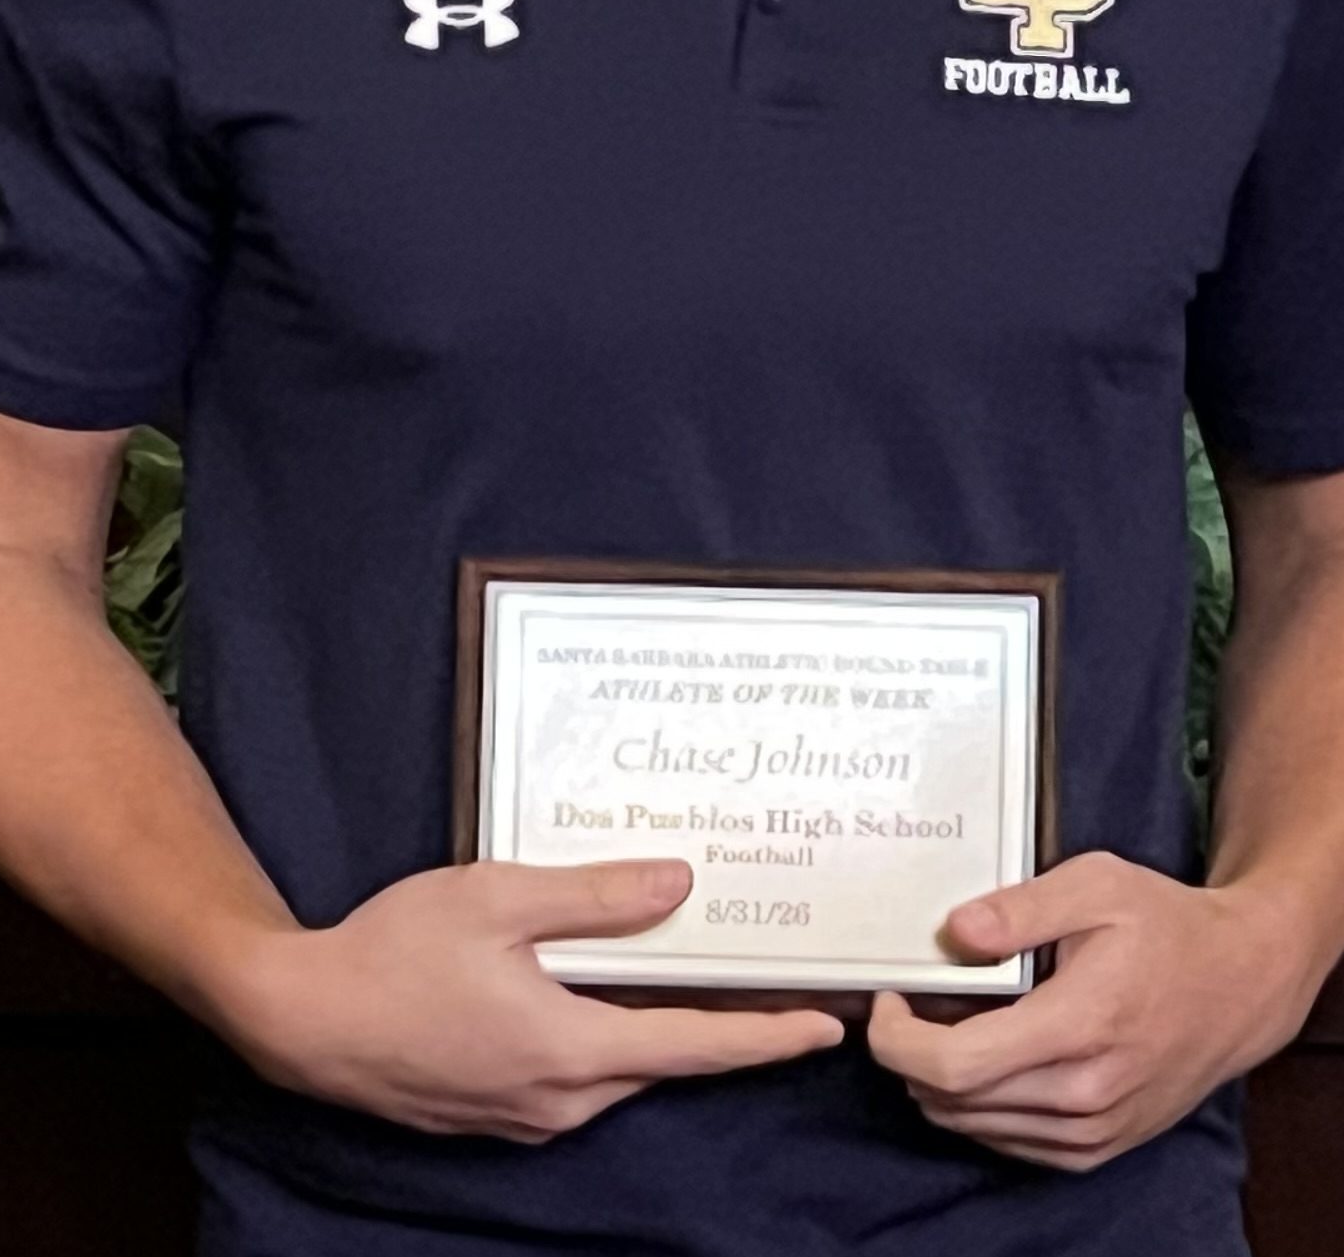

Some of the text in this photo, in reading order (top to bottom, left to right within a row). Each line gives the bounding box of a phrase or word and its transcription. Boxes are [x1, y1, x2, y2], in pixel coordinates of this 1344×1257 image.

[944, 57, 1132, 105] FOOTBALL
[588, 679, 934, 711] ATHLETE OF THE WEEK
[612, 728, 911, 784] Chase Johnson
[554, 801, 965, 840] Dos Pueblos High School
[705, 843, 814, 867] Football
[704, 898, 812, 927] 8/31/26
